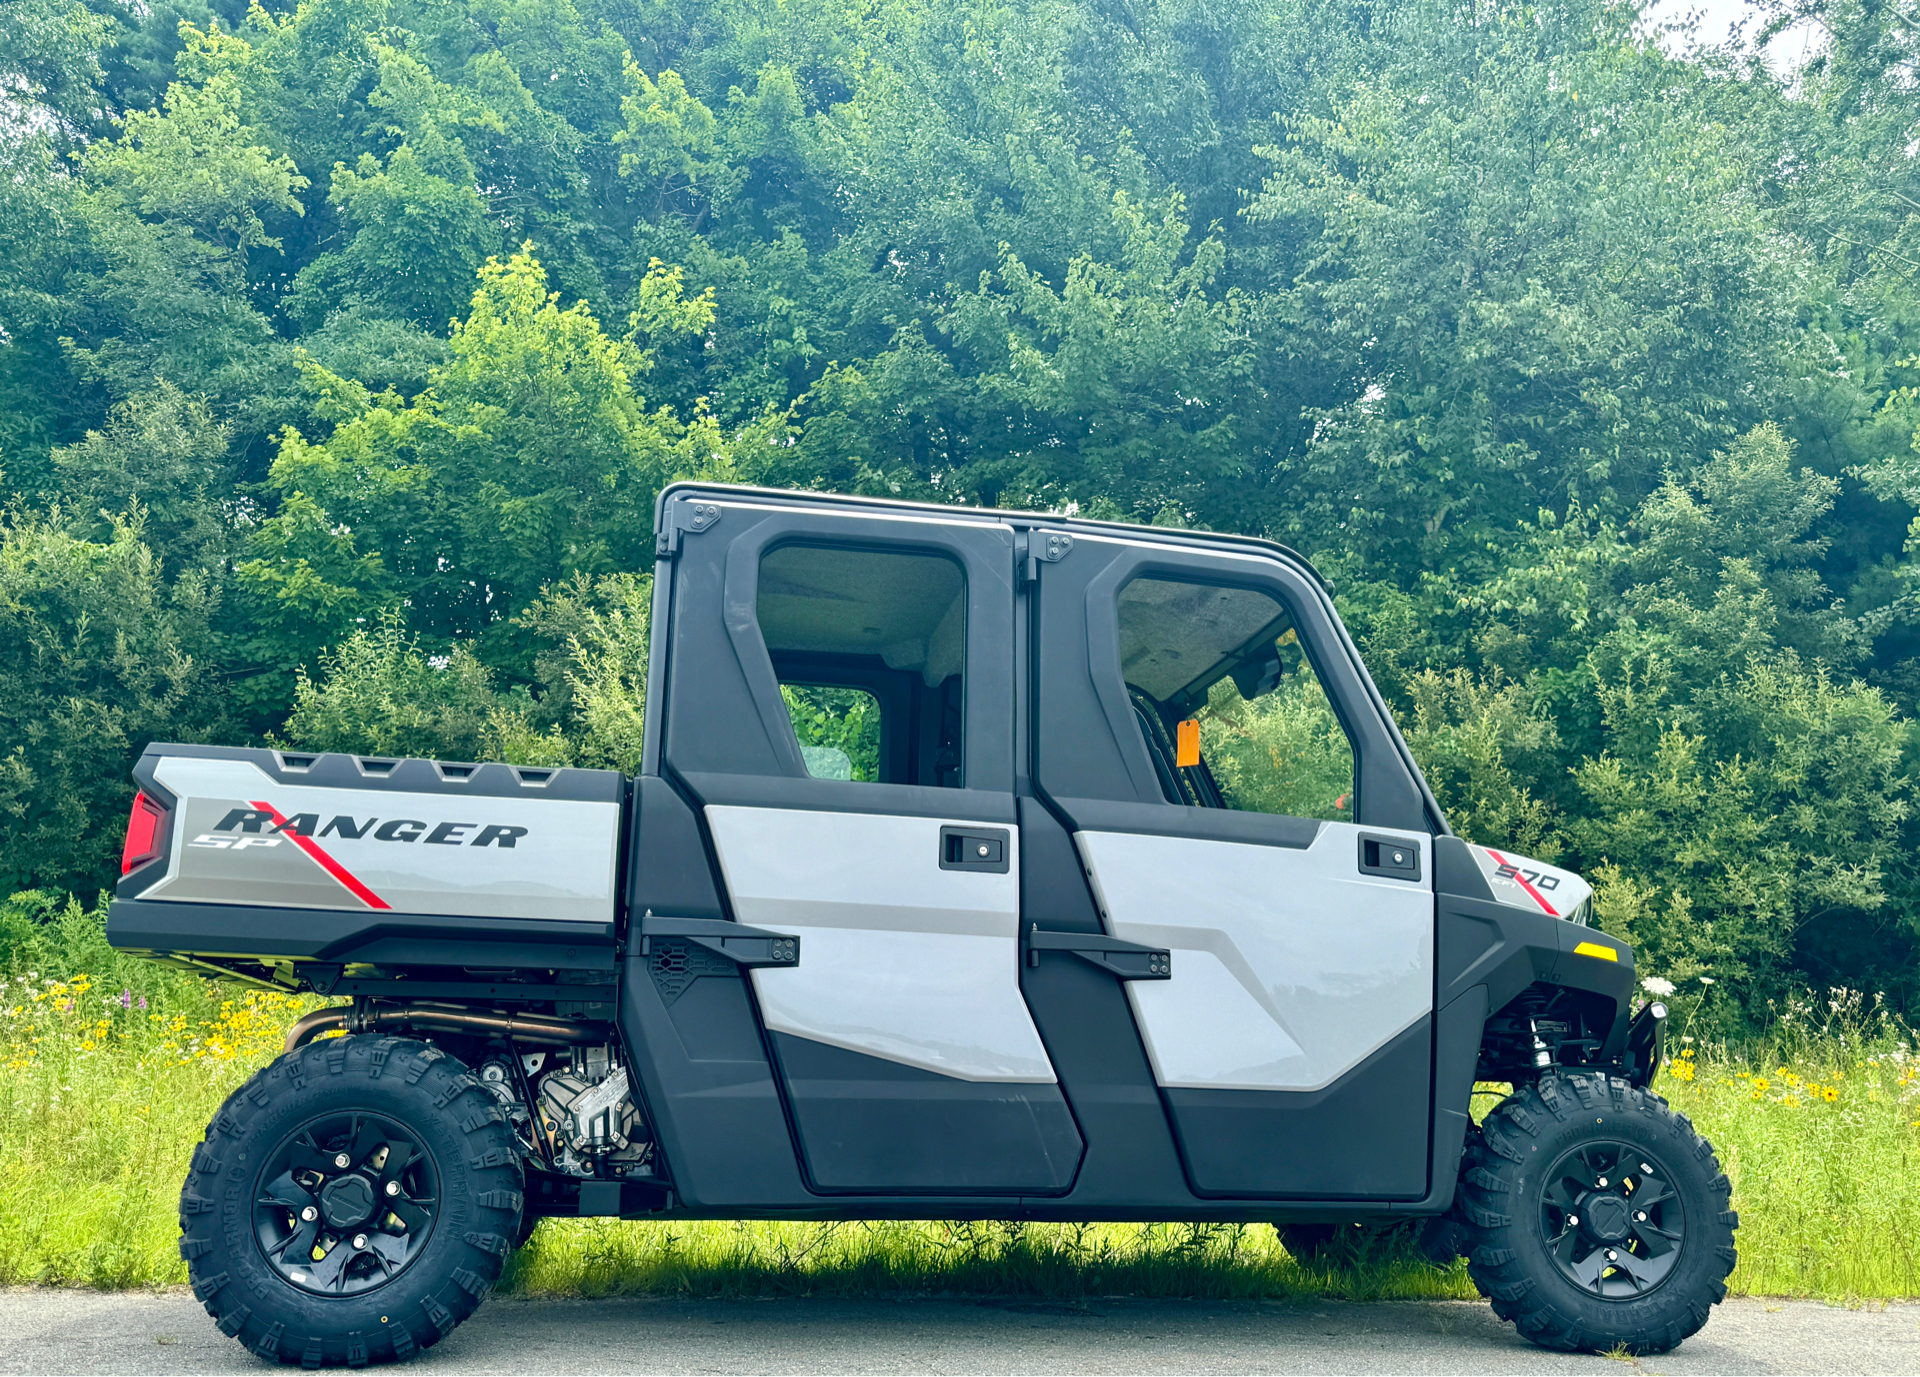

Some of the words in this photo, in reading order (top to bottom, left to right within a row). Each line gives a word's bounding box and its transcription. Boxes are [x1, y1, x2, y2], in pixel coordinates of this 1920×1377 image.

[188, 834, 282, 850] SP
[214, 809, 529, 848] RANGER
[1495, 864, 1561, 890] 570
[421, 1111, 469, 1240] X-TERRAIN
[223, 1185, 246, 1259] ARMOR
